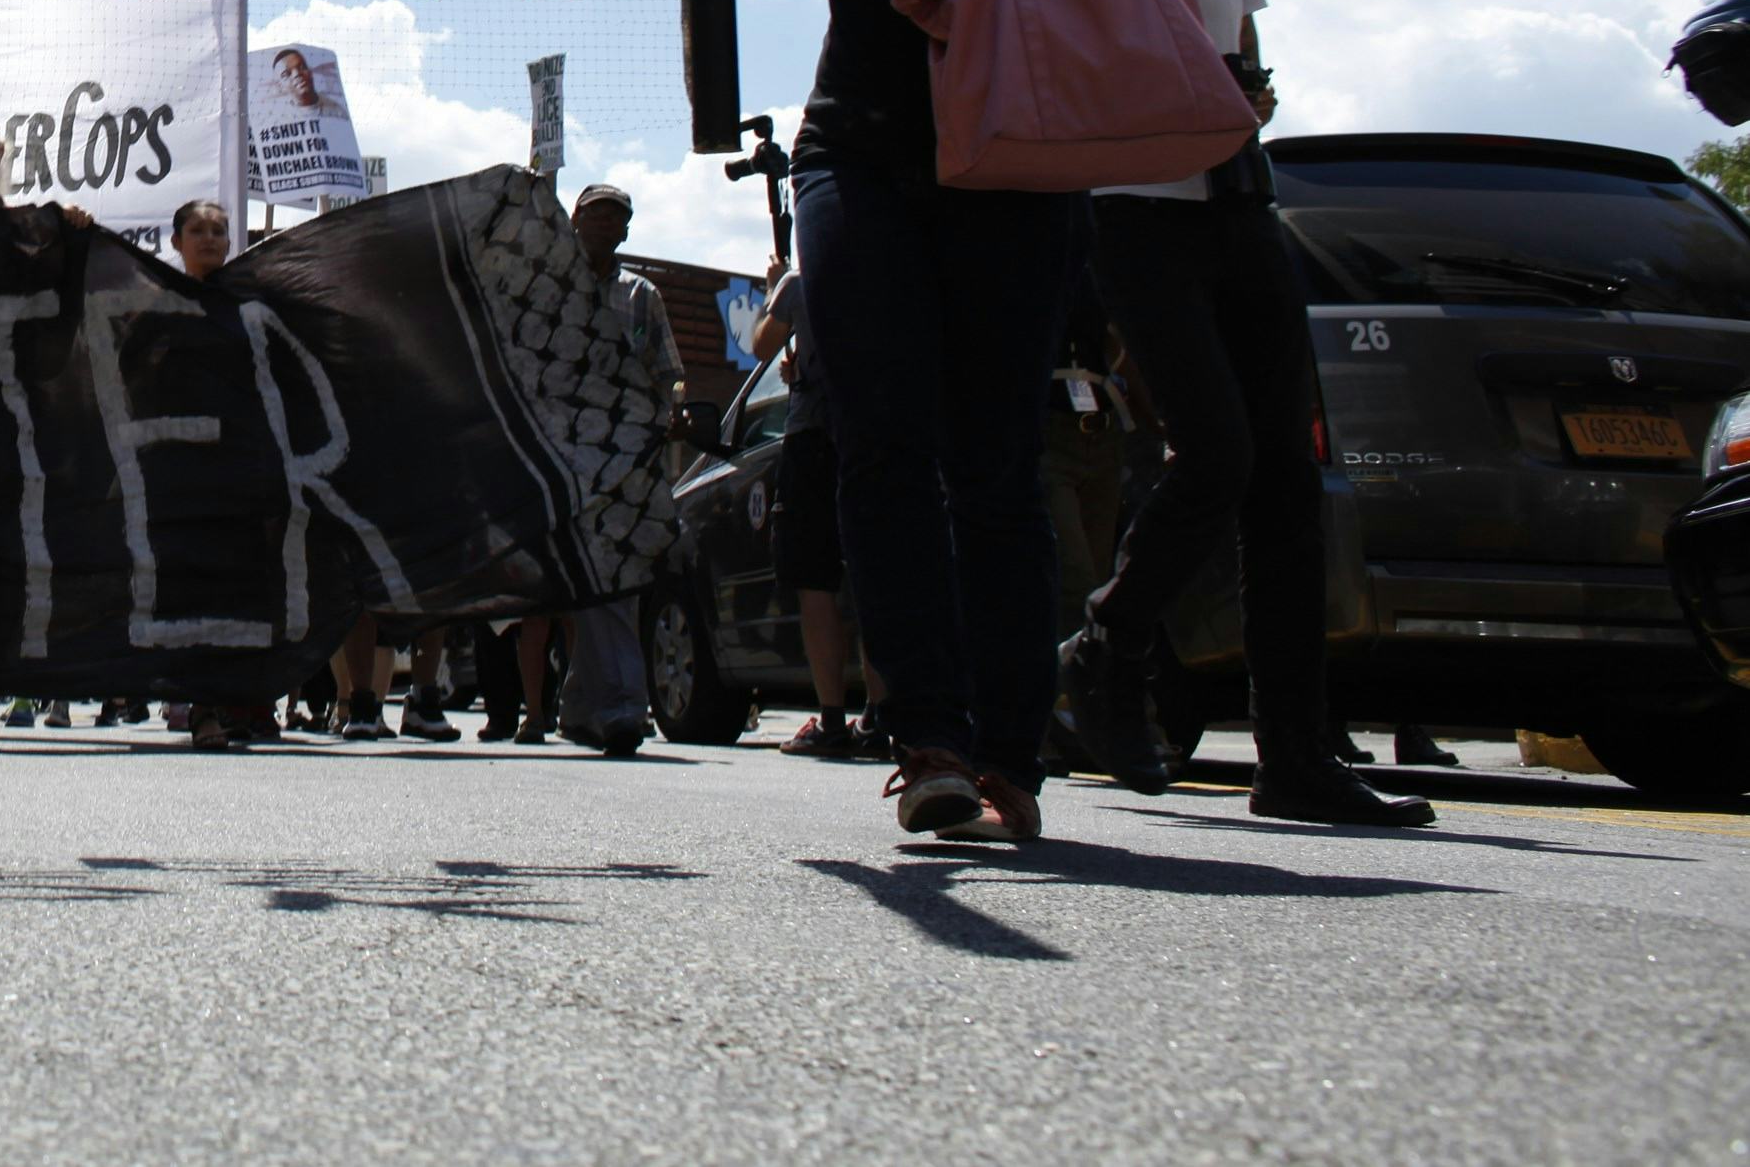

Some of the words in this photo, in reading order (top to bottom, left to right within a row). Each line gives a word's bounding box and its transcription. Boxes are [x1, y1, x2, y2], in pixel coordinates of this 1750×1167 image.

[260, 120, 307, 142] #SHUT
[309, 119, 321, 134] IT
[262, 139, 304, 160] DOWN
[306, 137, 330, 153] FOR
[266, 155, 325, 177] MICHAEL
[325, 155, 359, 173] BROWN
[270, 178, 299, 191] BLACK
[1346, 320, 1391, 351] 26
[1342, 452, 1446, 464] DODGE
